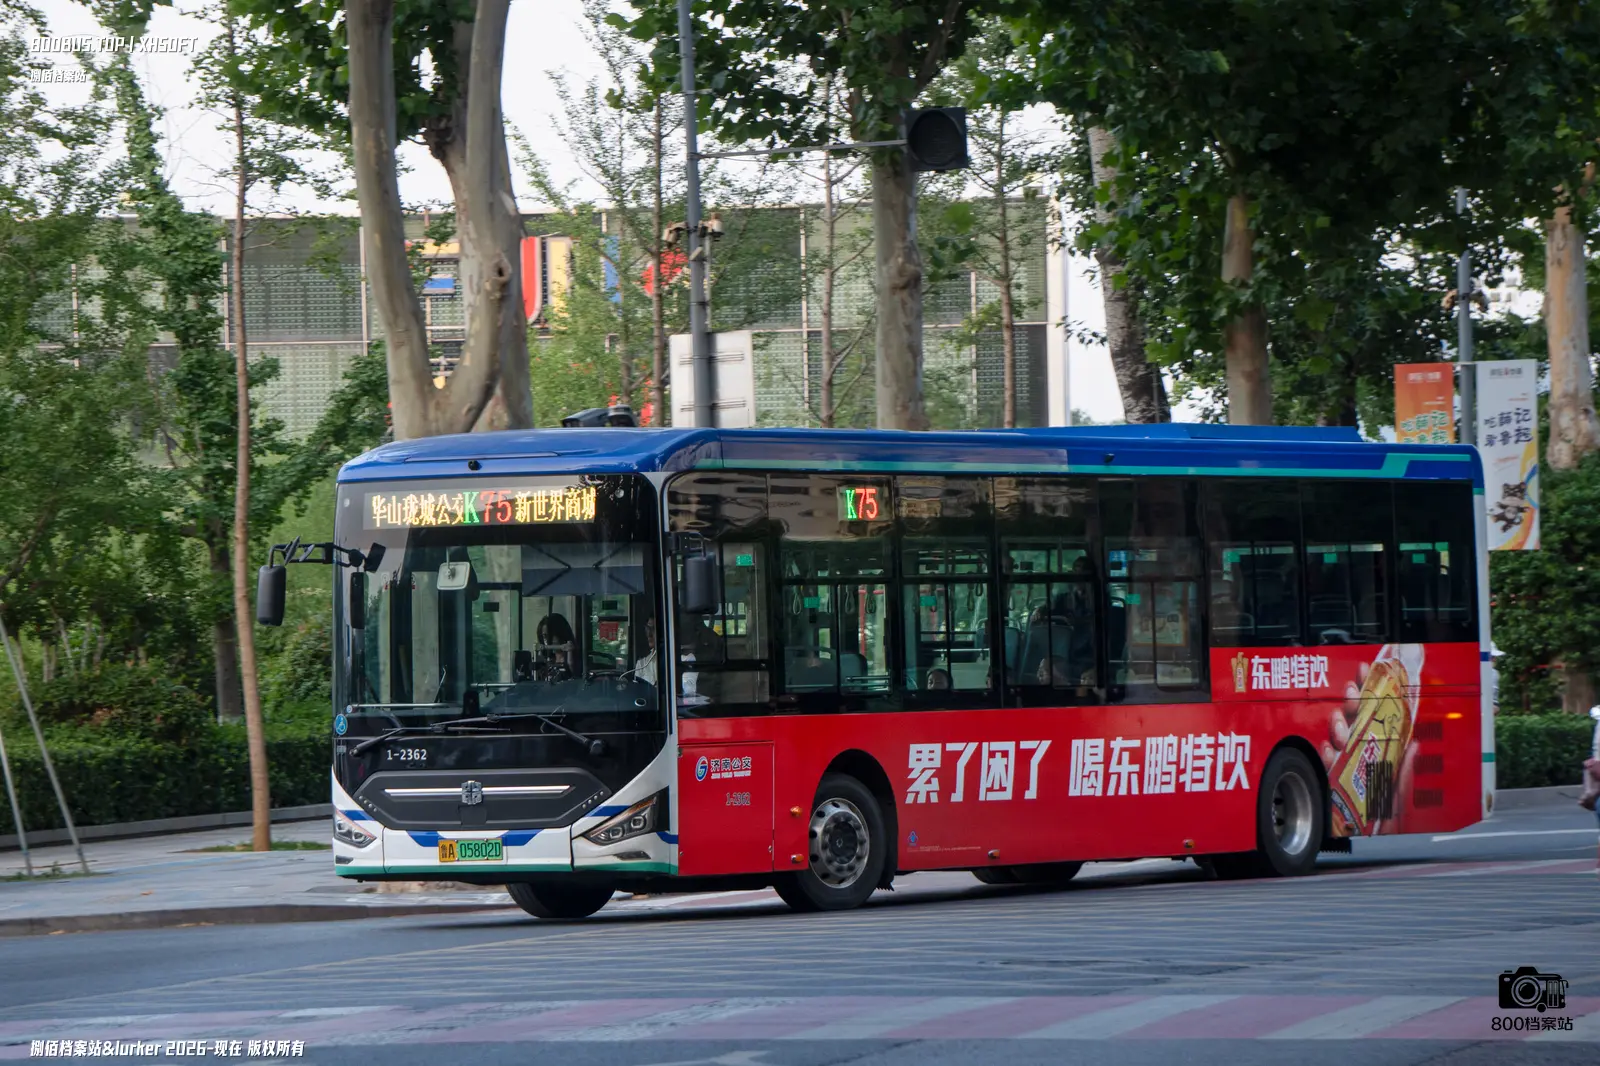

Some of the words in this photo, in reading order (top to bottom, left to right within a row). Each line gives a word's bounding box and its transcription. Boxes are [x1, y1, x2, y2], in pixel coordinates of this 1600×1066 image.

[463, 490, 512, 523] K75
[514, 486, 597, 522] 新世界商城
[845, 488, 878, 519] K75
[1251, 654, 1330, 690] 东鹏特饮
[387, 748, 427, 760] 1-2362
[710, 756, 752, 772] 济南公交
[904, 740, 1052, 804] 累了困了
[1068, 730, 1251, 797] 喝东鹏特饮
[726, 792, 751, 806] 1-2362
